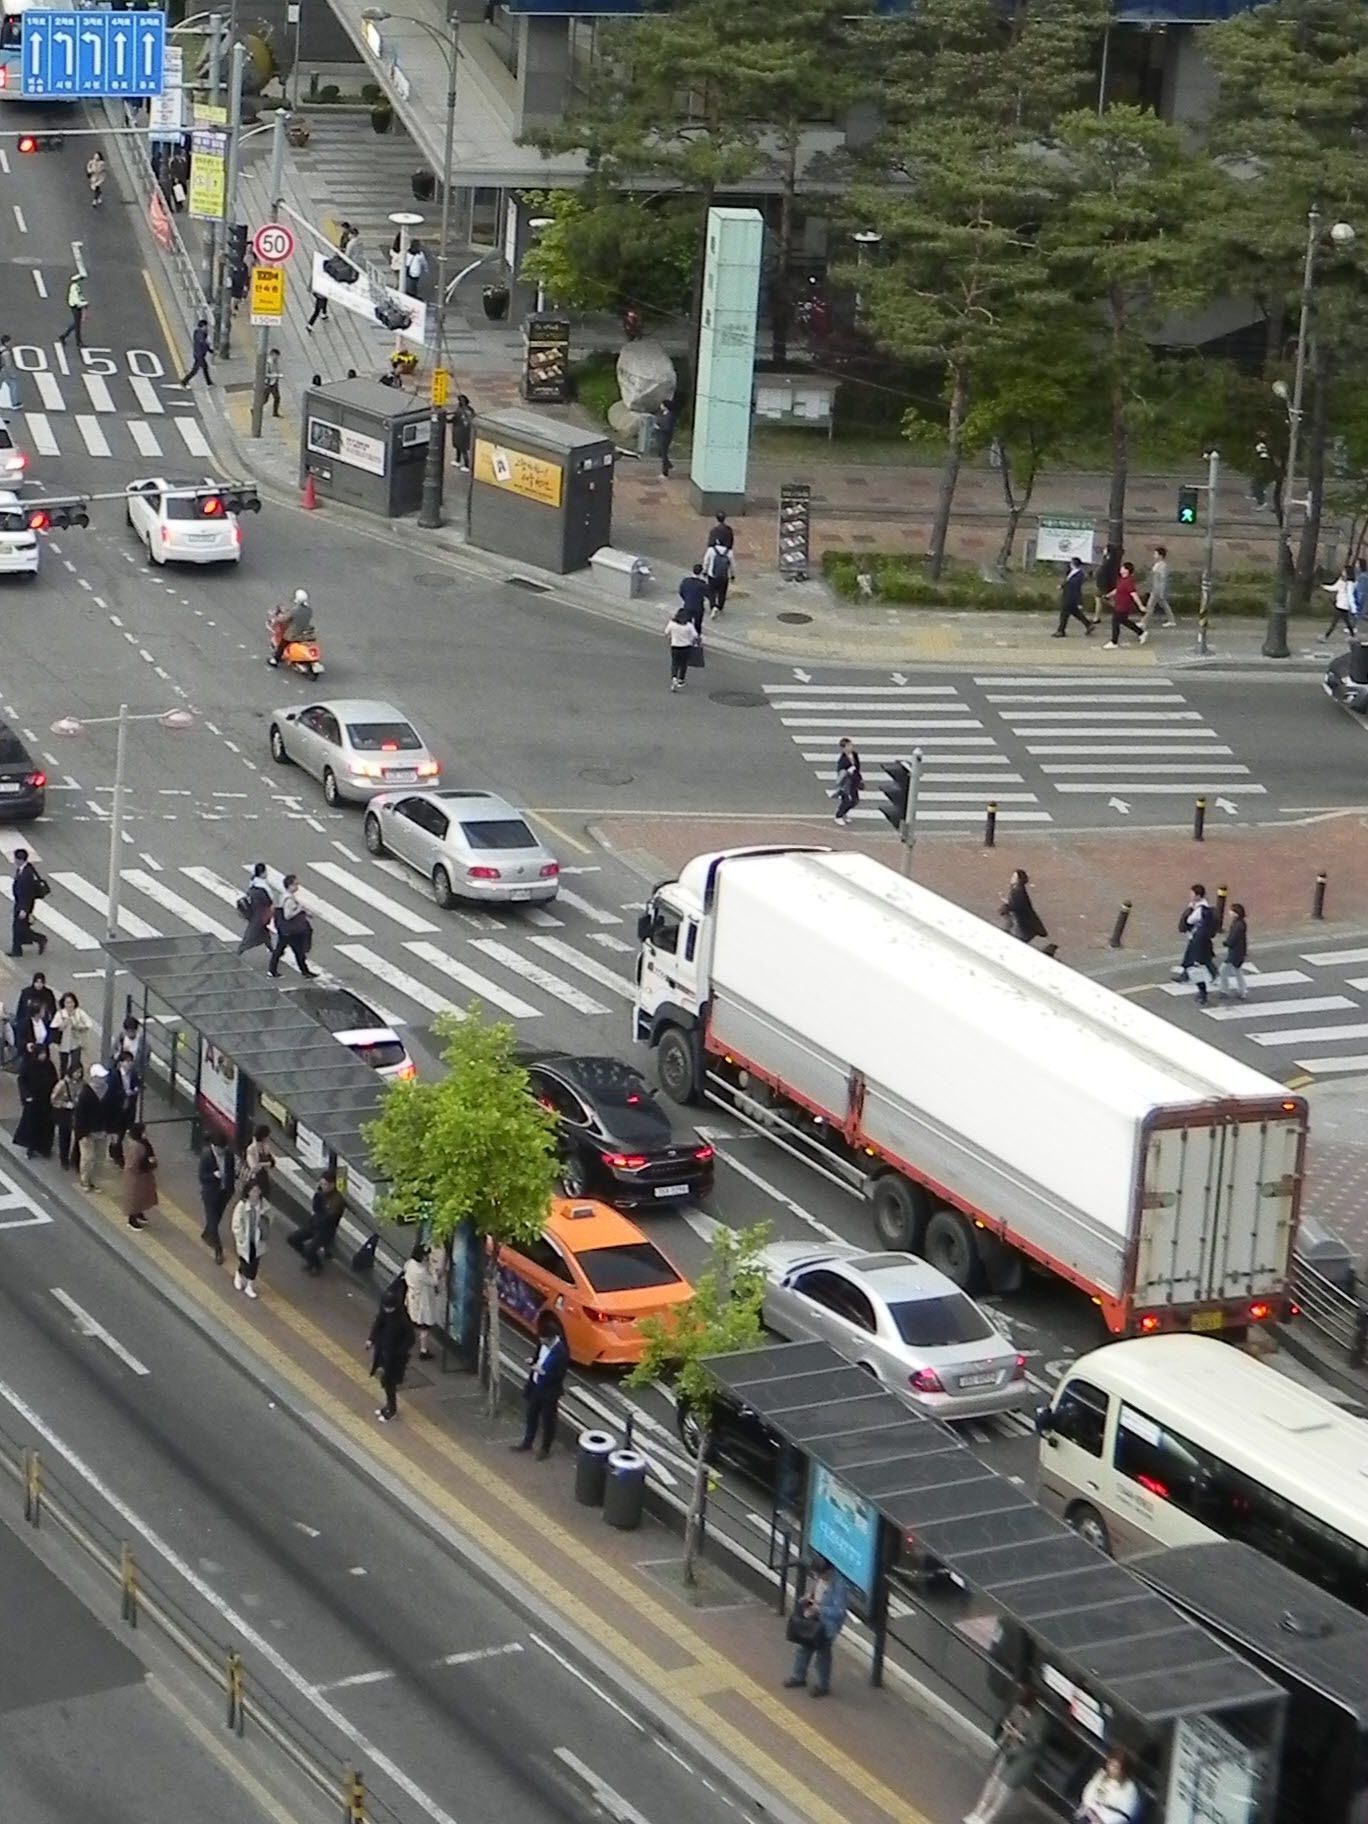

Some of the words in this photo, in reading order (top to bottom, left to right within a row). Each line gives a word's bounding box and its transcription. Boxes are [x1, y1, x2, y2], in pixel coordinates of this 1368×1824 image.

[26, 17, 46, 26] 1차로
[54, 17, 75, 26] 2차로
[83, 17, 103, 26] 3차로
[111, 17, 131, 26] 4차로
[140, 17, 160, 26] 5차로
[262, 234, 286, 253] 50
[80, 347, 166, 378] 50
